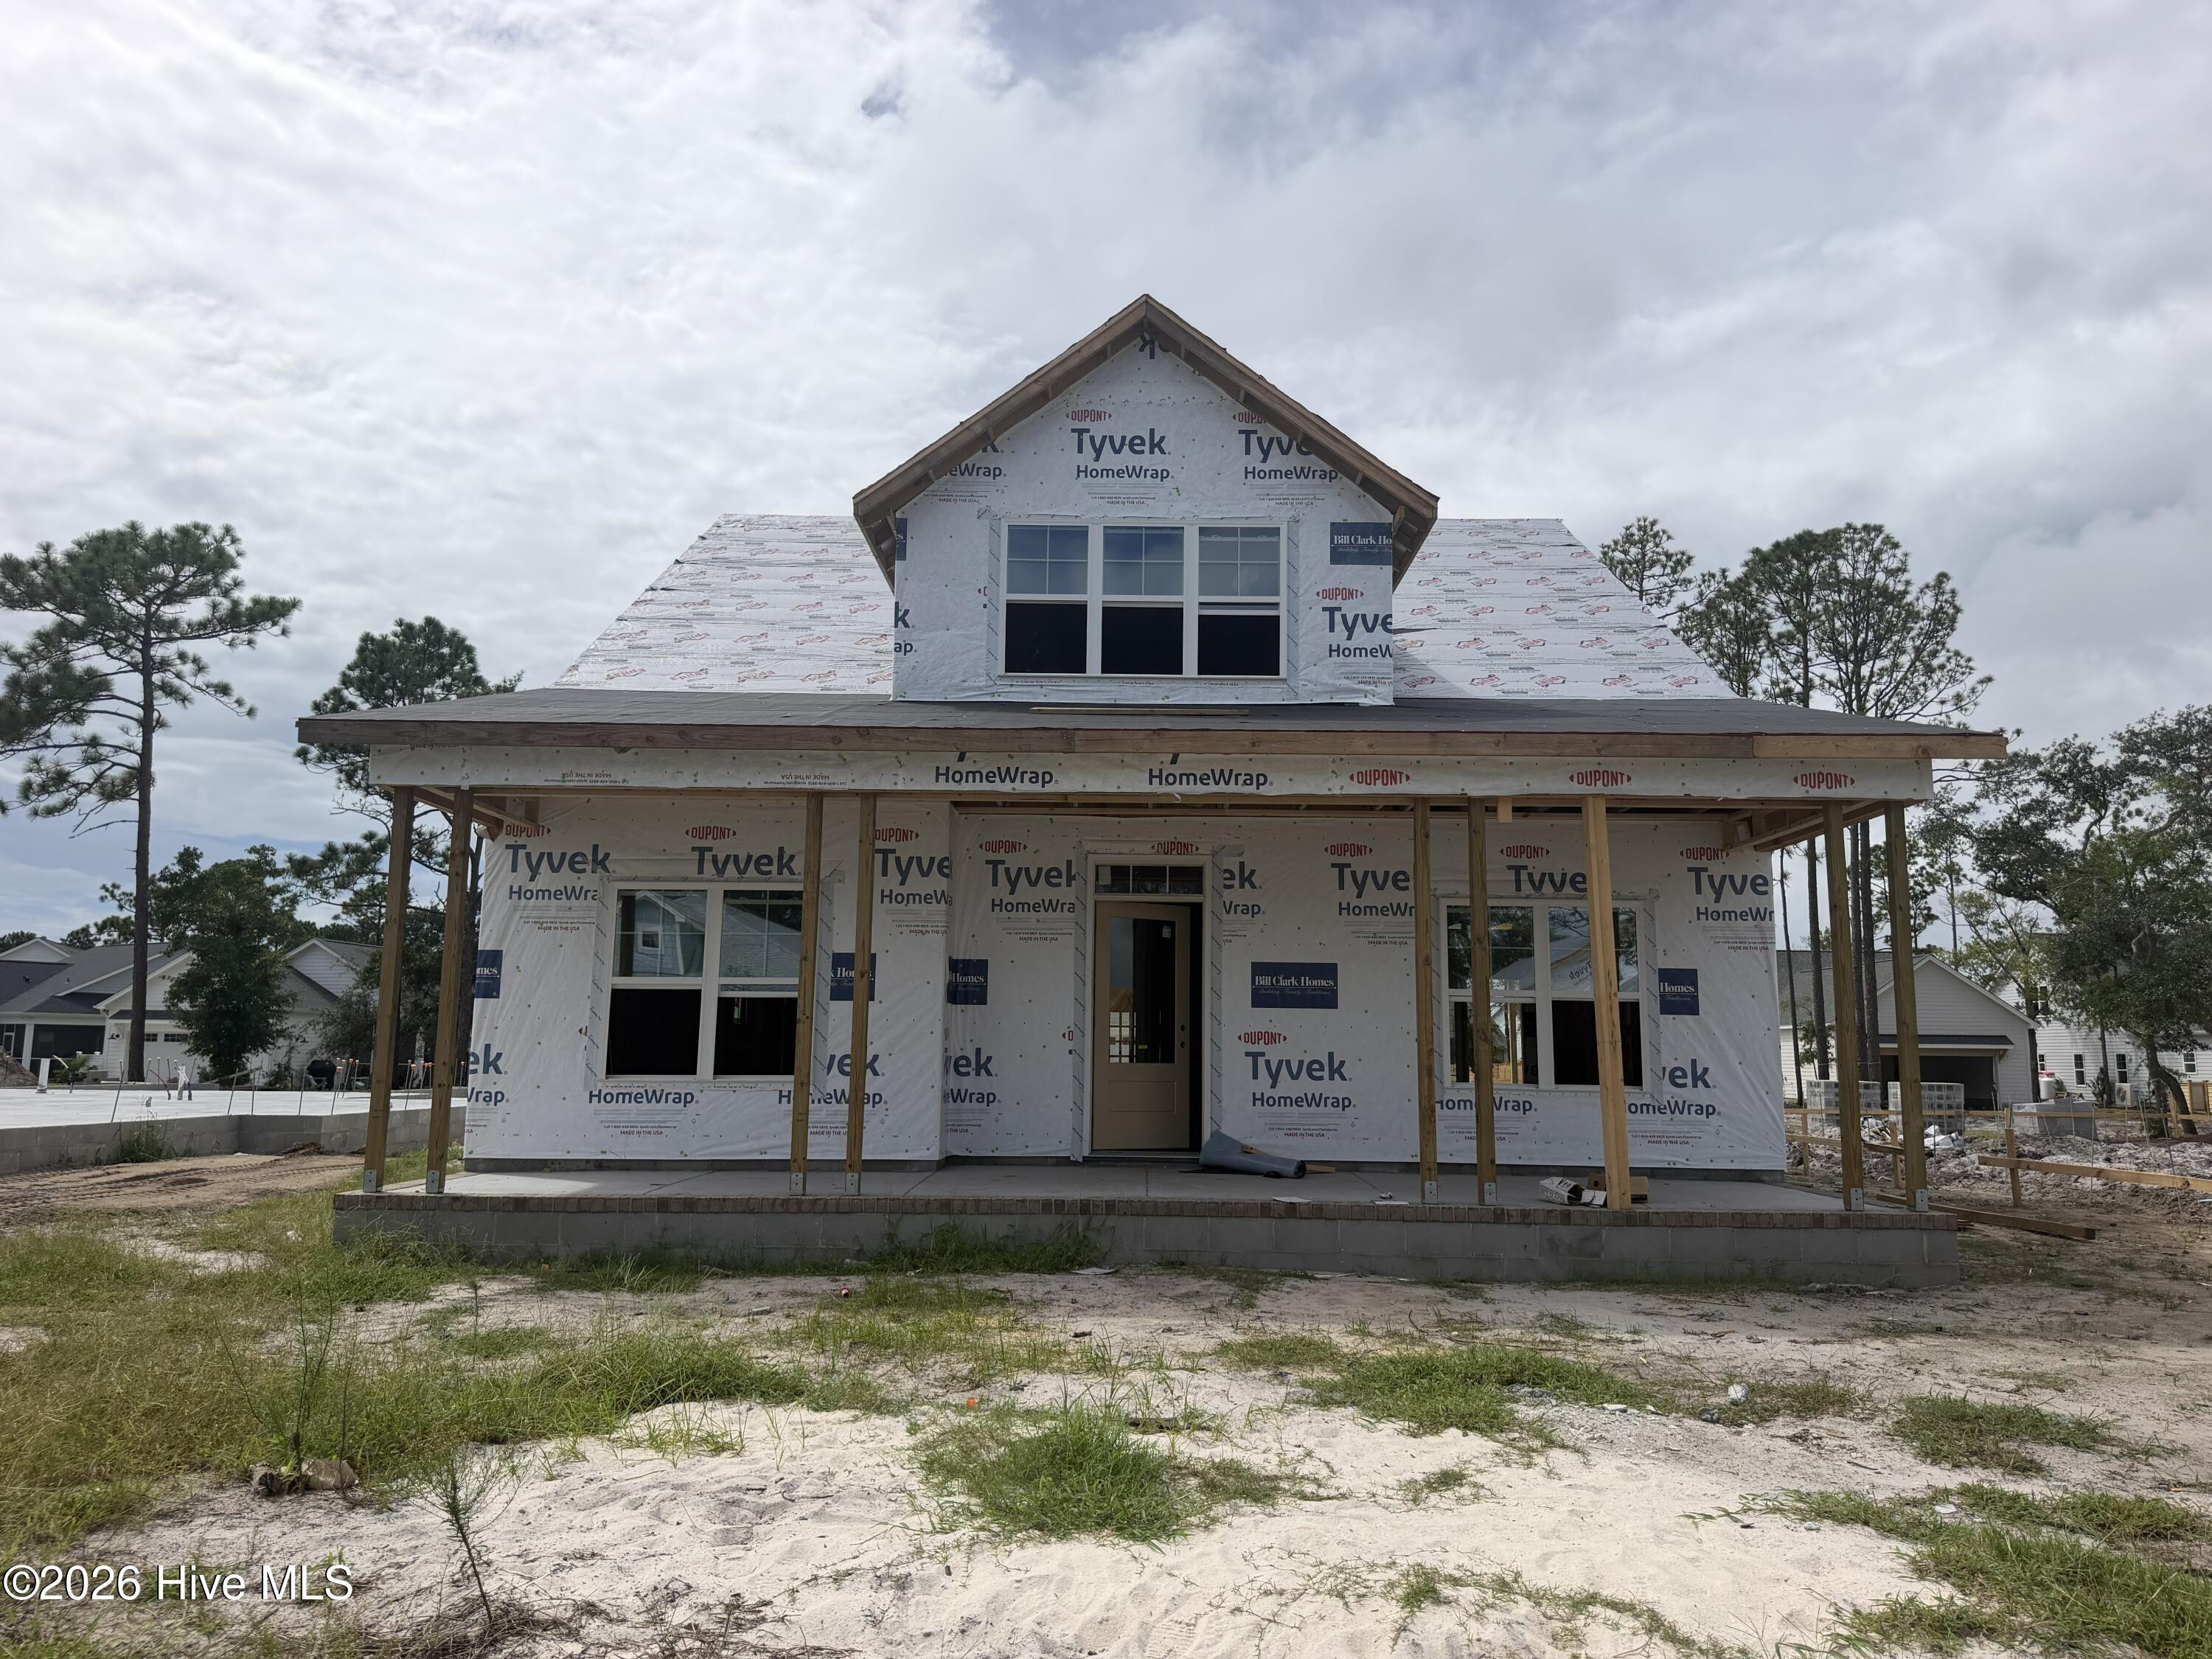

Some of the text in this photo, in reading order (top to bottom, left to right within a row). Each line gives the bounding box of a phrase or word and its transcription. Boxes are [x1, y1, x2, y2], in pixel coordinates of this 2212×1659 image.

[1071, 409, 1107, 422] DUPONT
[1071, 428, 1166, 462] Tyvek
[1077, 465, 1169, 482] HomeWrap
[1244, 466, 1338, 483] HomeWrap
[1334, 535, 1349, 544] Bill
[1351, 535, 1377, 545] Clark
[1321, 588, 1360, 601] DUPONT
[1322, 607, 1392, 641] Tyve
[1329, 644, 1392, 658] HomeW
[936, 766, 1054, 788] HomeWrap
[1148, 768, 1269, 790] HomeWrap
[1357, 770, 1404, 787] DUPONT
[1576, 770, 1625, 788] DUPONT
[1801, 771, 1849, 790] DUPONT
[506, 824, 546, 838] DUPONT
[692, 826, 731, 840] DUPONT
[875, 828, 914, 842] DUPONT
[985, 840, 1023, 854] DUPONT
[1158, 841, 1194, 855] DUPONT
[1329, 843, 1368, 858] DUPONT
[1506, 845, 1545, 859] DUPONT
[1686, 846, 1723, 861] DUPONT
[505, 844, 611, 882] Tyvek
[875, 848, 950, 886] Tyve
[1331, 863, 1411, 899] Tyve
[1687, 866, 1769, 903] Tyve
[509, 885, 598, 900] HomeWra
[991, 898, 1075, 913] HomeWra
[1338, 902, 1415, 917] HomeWr
[1696, 906, 1775, 922] HomeWr
[1255, 975, 1335, 987] Bill Clark Homes
[1660, 982, 1694, 992] Homes
[1244, 1032, 1282, 1046] DUPONT
[1245, 1051, 1348, 1088] Tyvek
[589, 1089, 695, 1107] HomeWrap
[1253, 1093, 1352, 1111] HomeWrap
[1627, 1100, 1717, 1119] omeWrap
